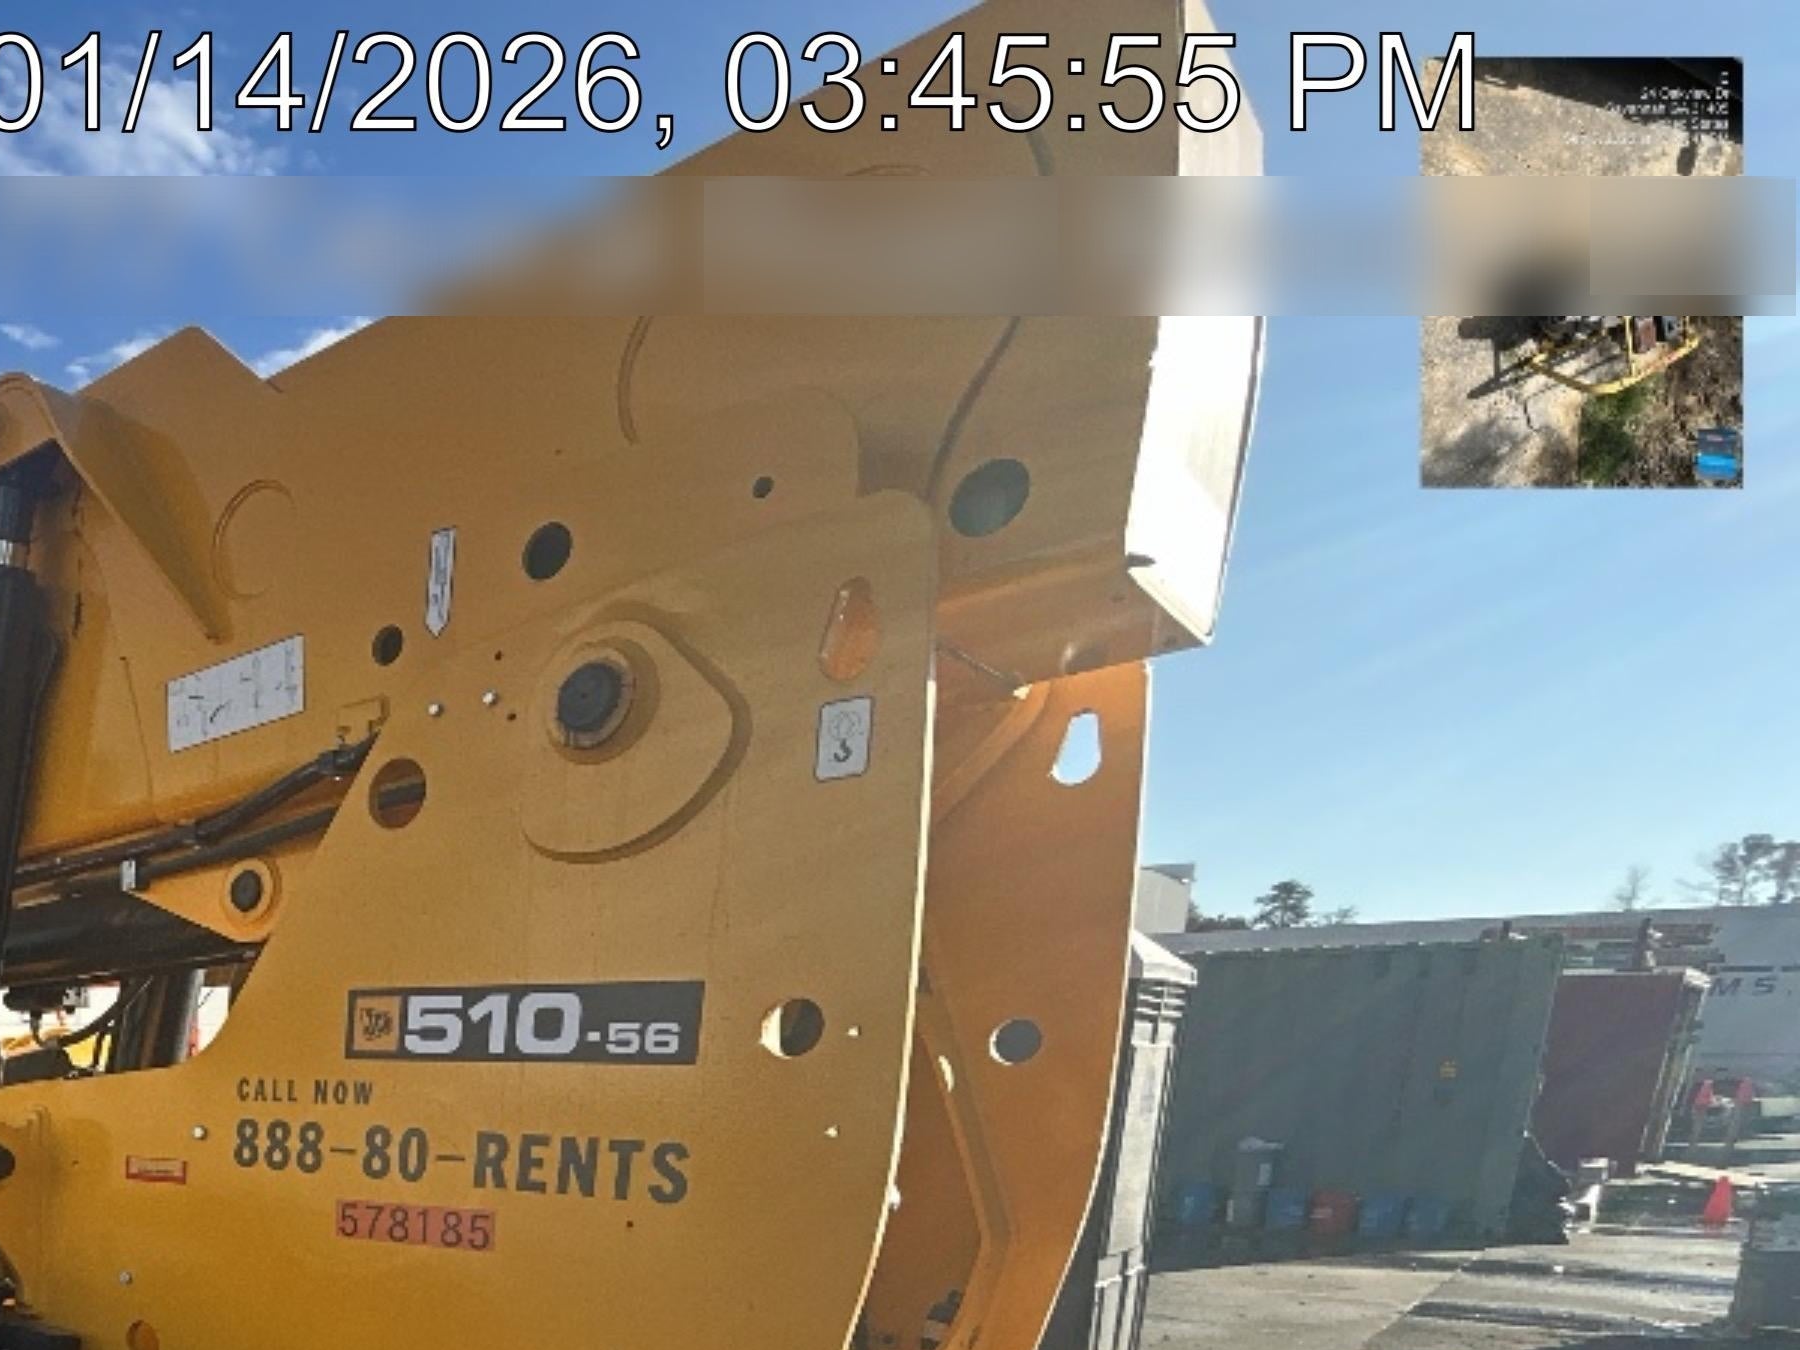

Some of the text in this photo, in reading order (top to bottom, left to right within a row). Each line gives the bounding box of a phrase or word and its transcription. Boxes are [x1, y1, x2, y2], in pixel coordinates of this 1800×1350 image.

[403, 992, 681, 1055] 510-56
[236, 1077, 374, 1105] CALL NOW
[233, 1117, 691, 1204] 888-80-RENTS
[337, 1202, 491, 1250] 578185
